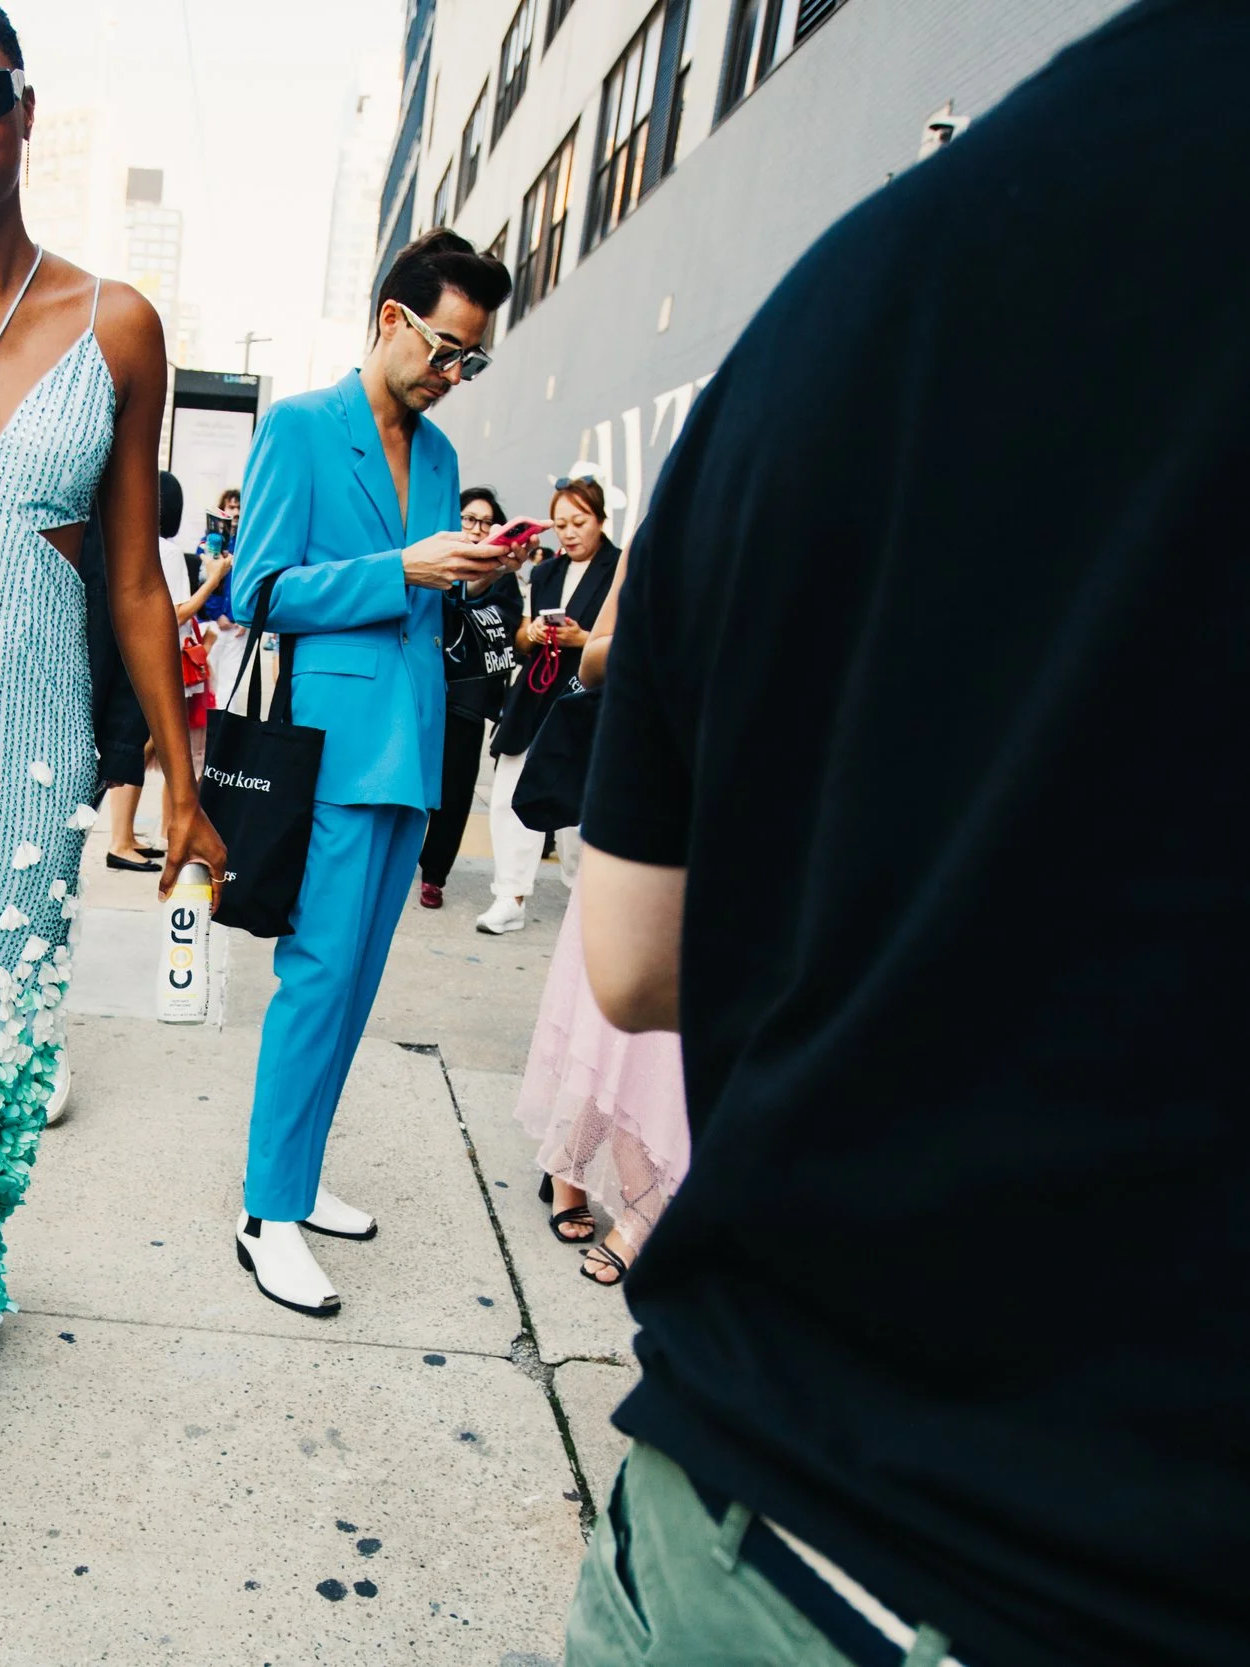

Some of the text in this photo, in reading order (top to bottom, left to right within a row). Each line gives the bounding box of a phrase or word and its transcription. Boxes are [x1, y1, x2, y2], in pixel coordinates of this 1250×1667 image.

[484, 646, 516, 674] BRAVE
[235, 770, 271, 792] korea
[169, 907, 196, 990] core
